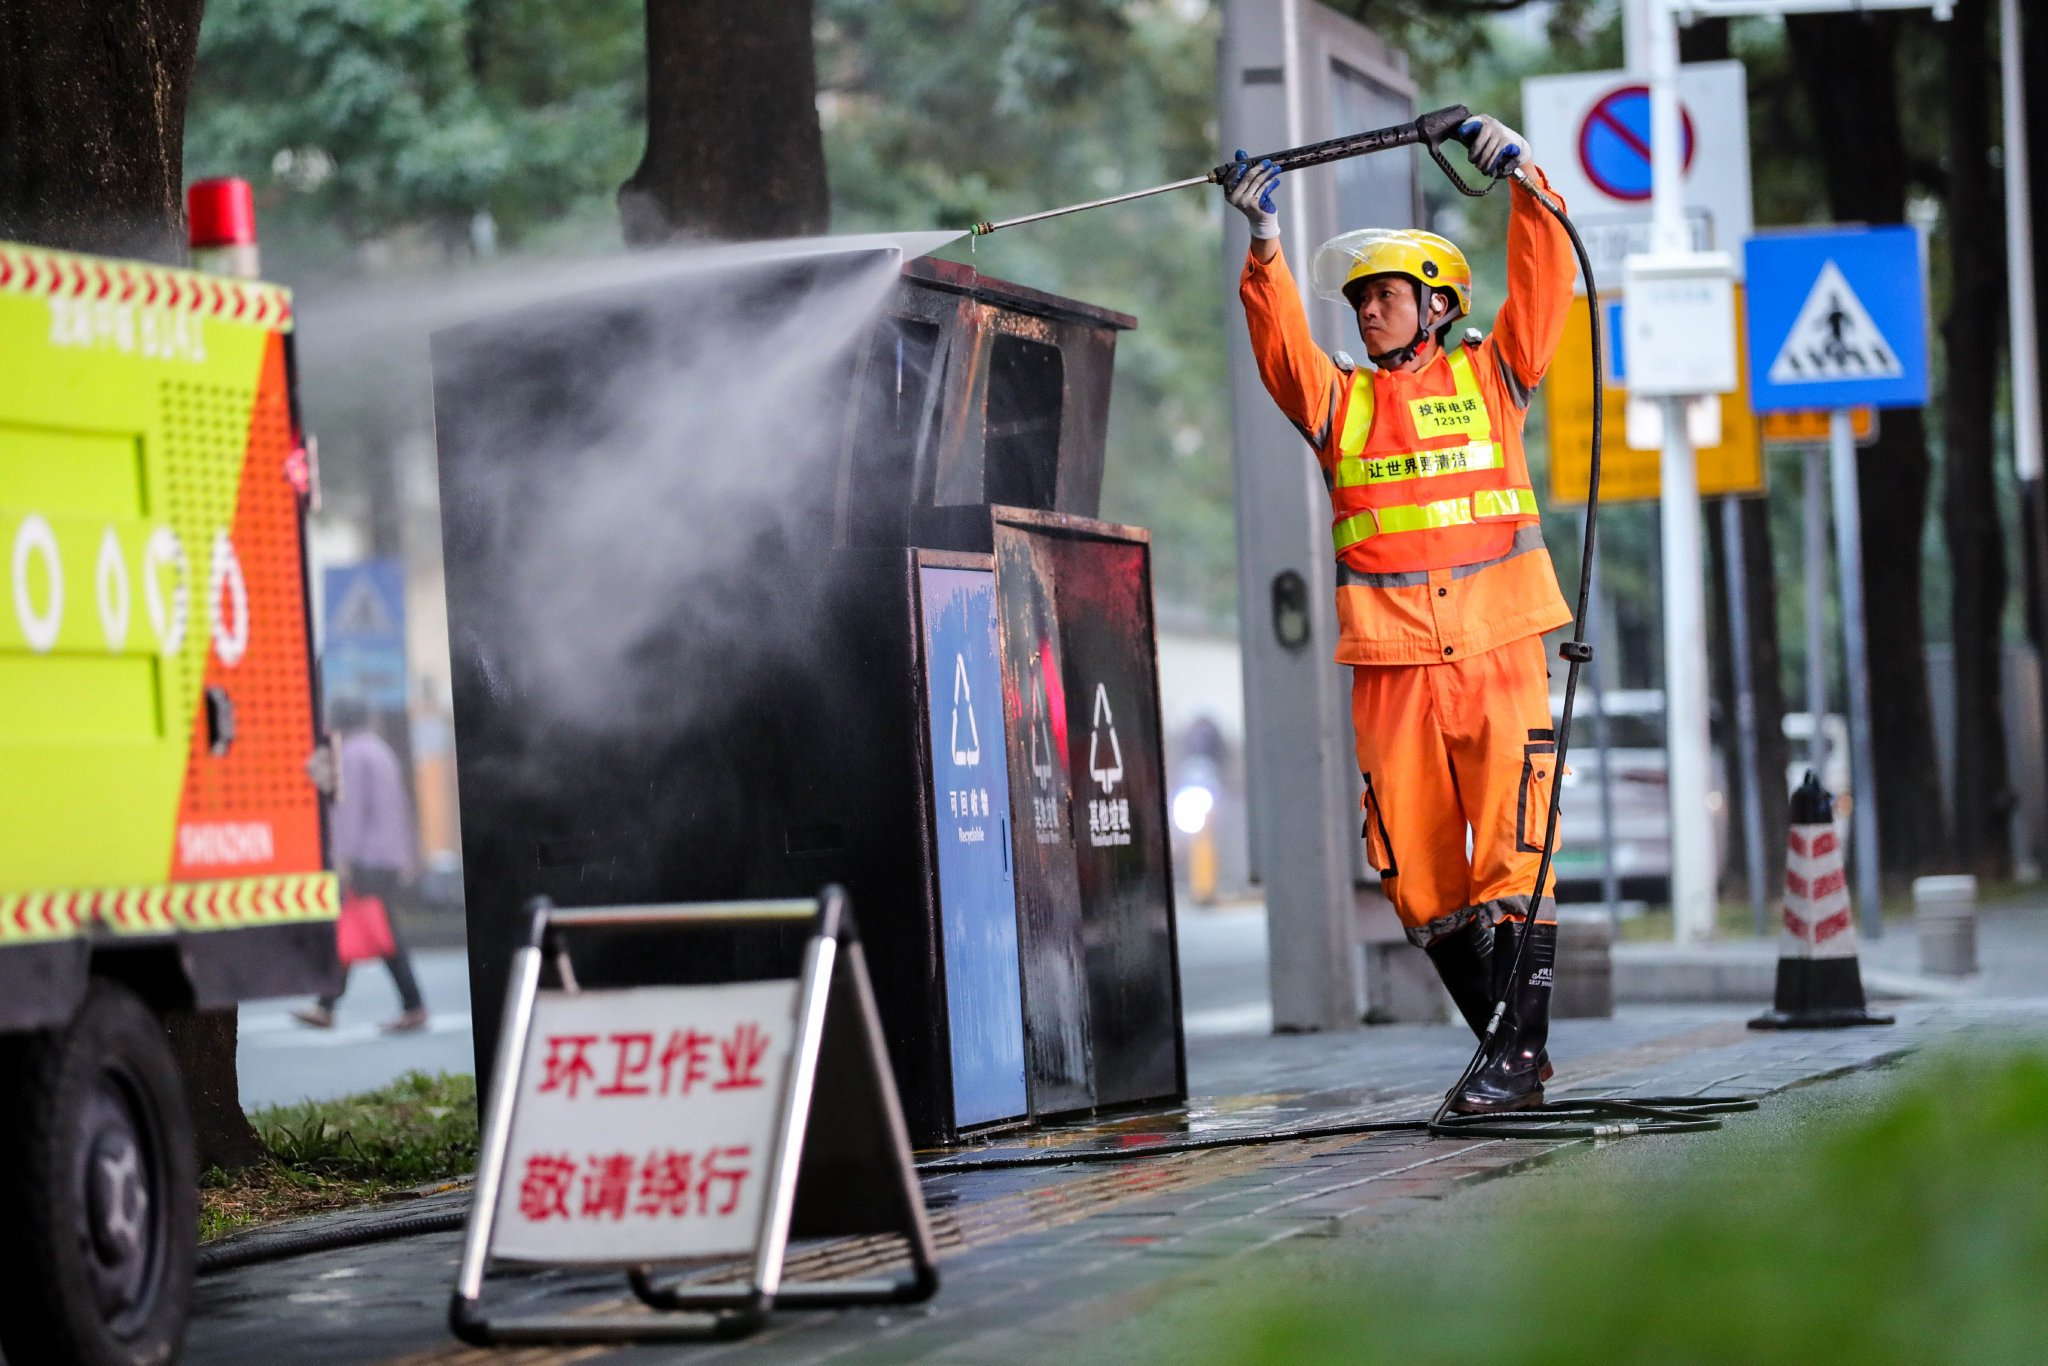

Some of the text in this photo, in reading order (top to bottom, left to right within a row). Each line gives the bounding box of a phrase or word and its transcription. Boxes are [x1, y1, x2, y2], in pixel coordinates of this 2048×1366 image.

[1419, 399, 1477, 416] 投诉电话
[1434, 415, 1471, 427] 12319
[1368, 451, 1467, 478] 让世界更清洁
[949, 788, 989, 818] 可回收物
[537, 1023, 771, 1101] 环卫作业
[517, 1146, 752, 1222] 敬请绕行
